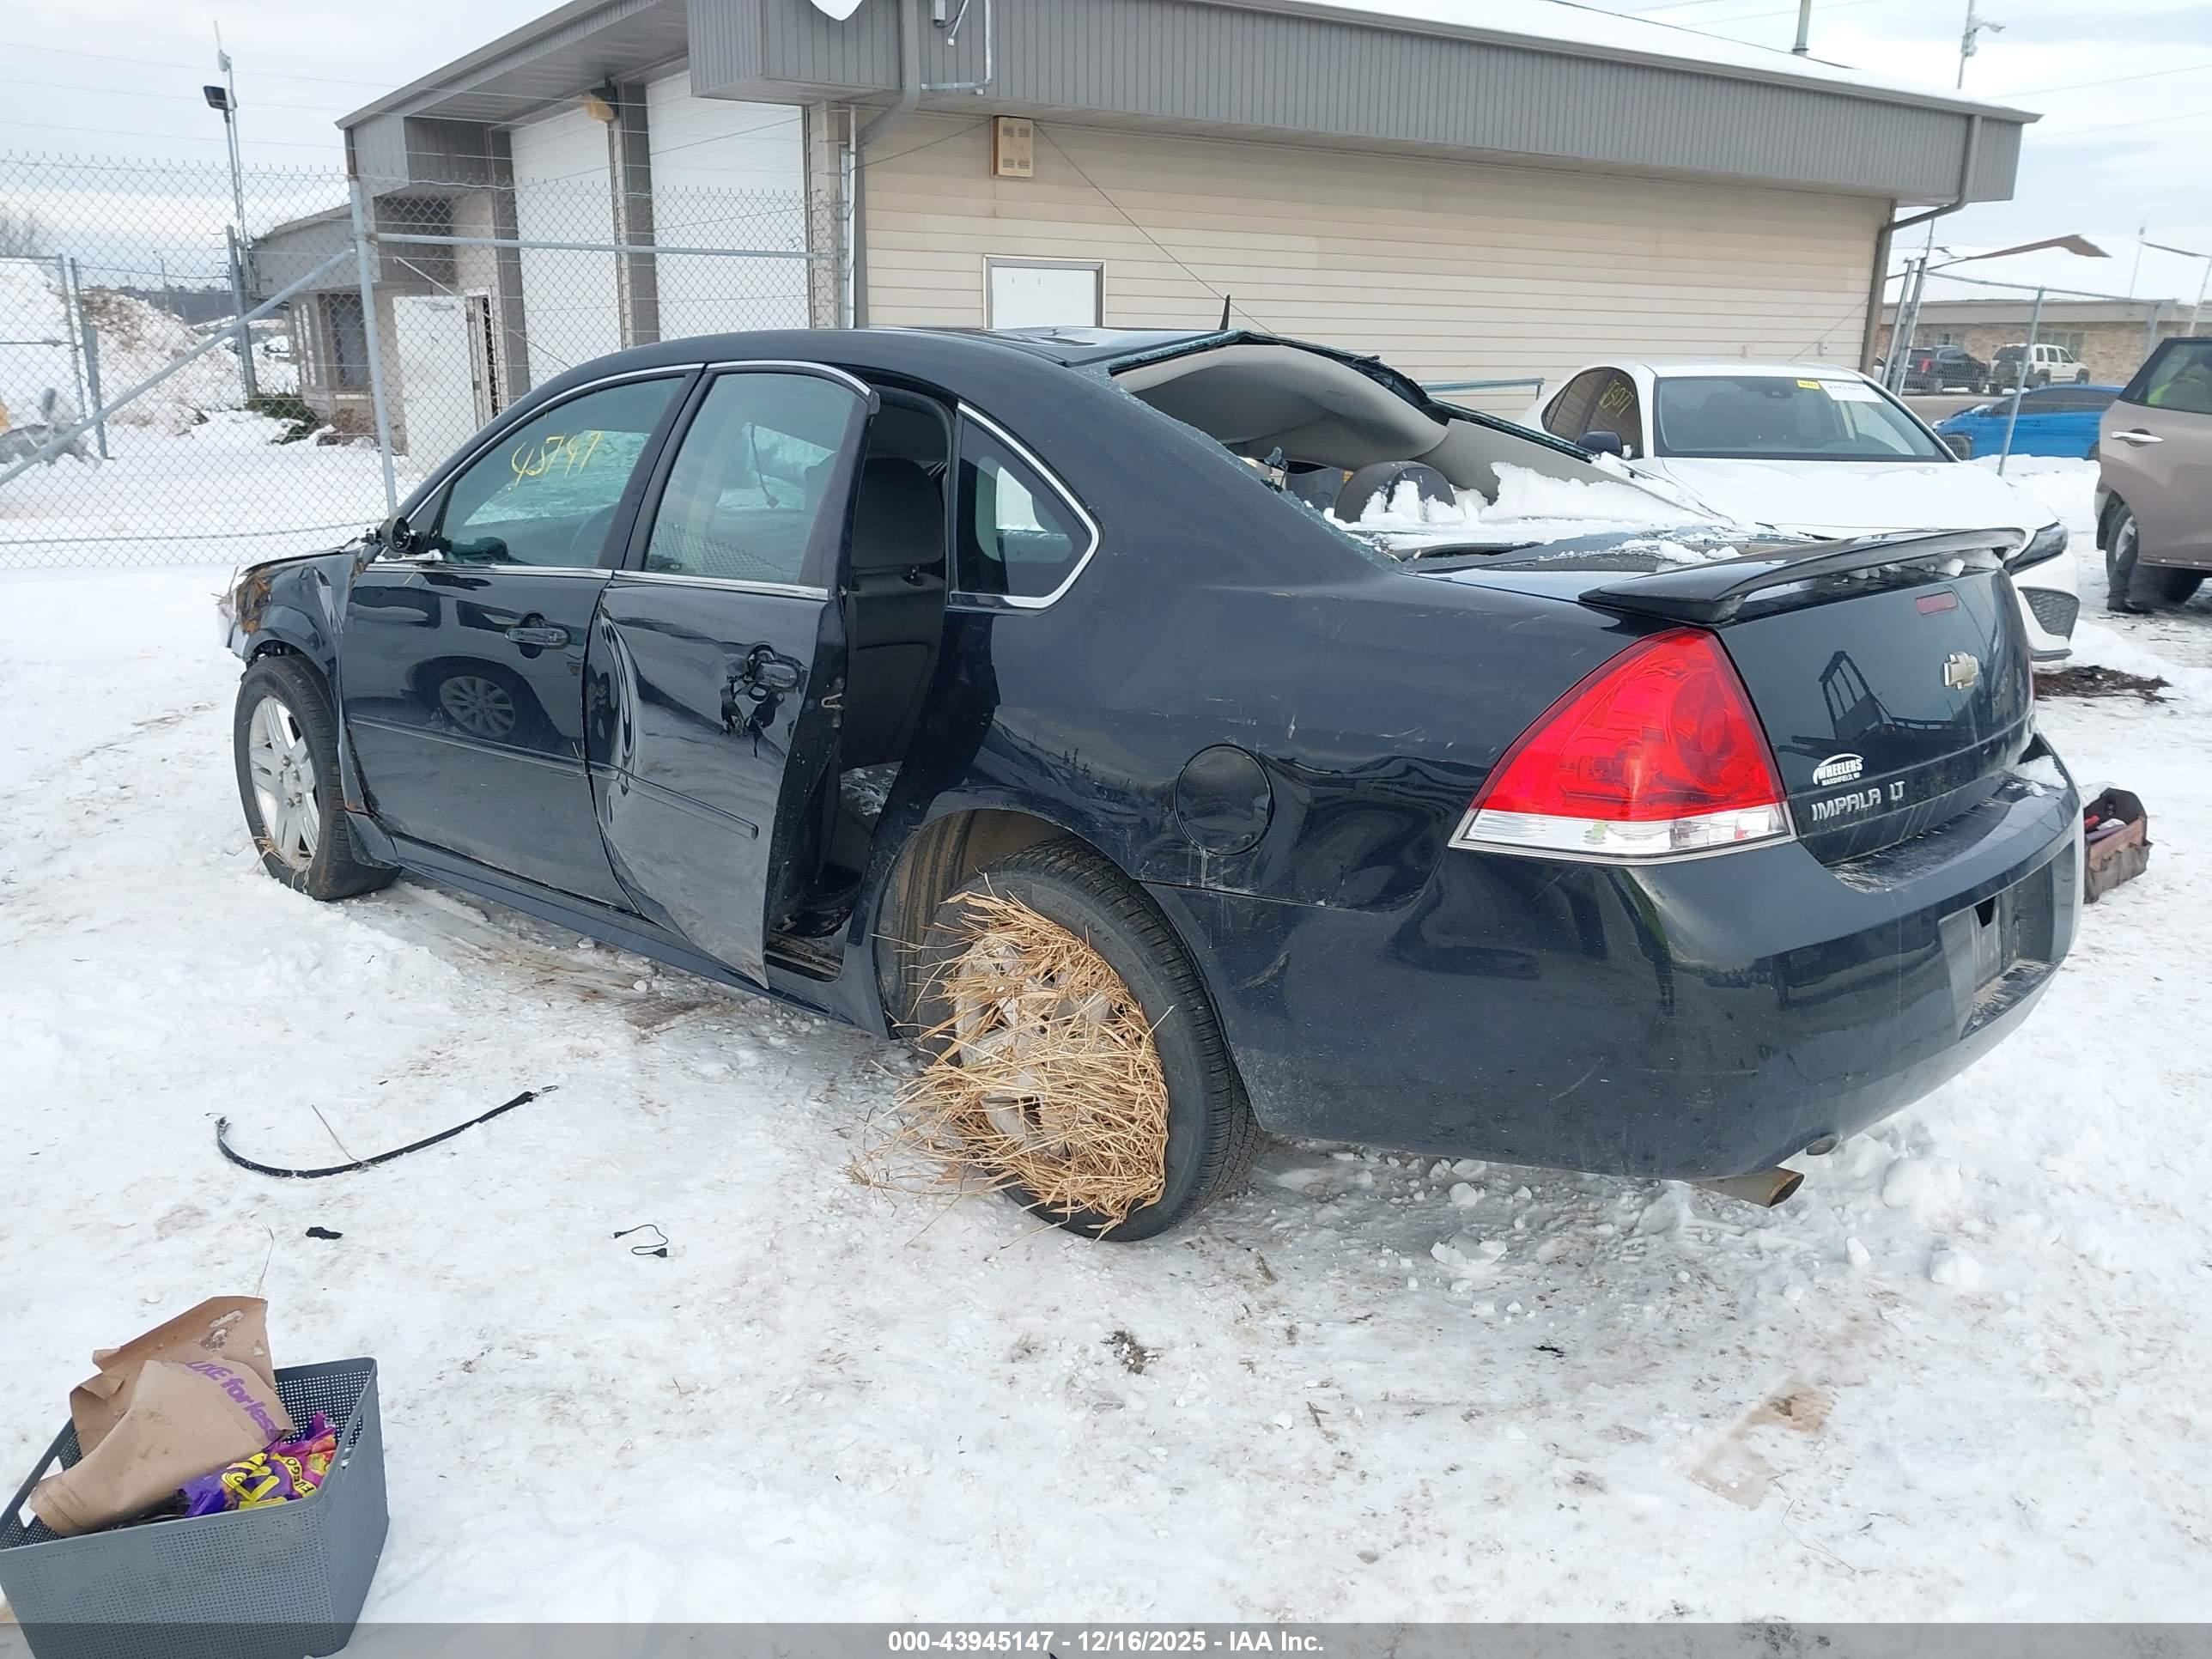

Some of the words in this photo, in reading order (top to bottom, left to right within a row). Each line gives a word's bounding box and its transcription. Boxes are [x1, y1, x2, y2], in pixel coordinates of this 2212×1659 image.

[1817, 758, 1863, 780] WHEELERS
[1810, 787, 1882, 822] IMPALA
[1888, 781, 1905, 801] LT
[219, 1377, 255, 1404] for
[285, 1457, 315, 1494] FUEGO
